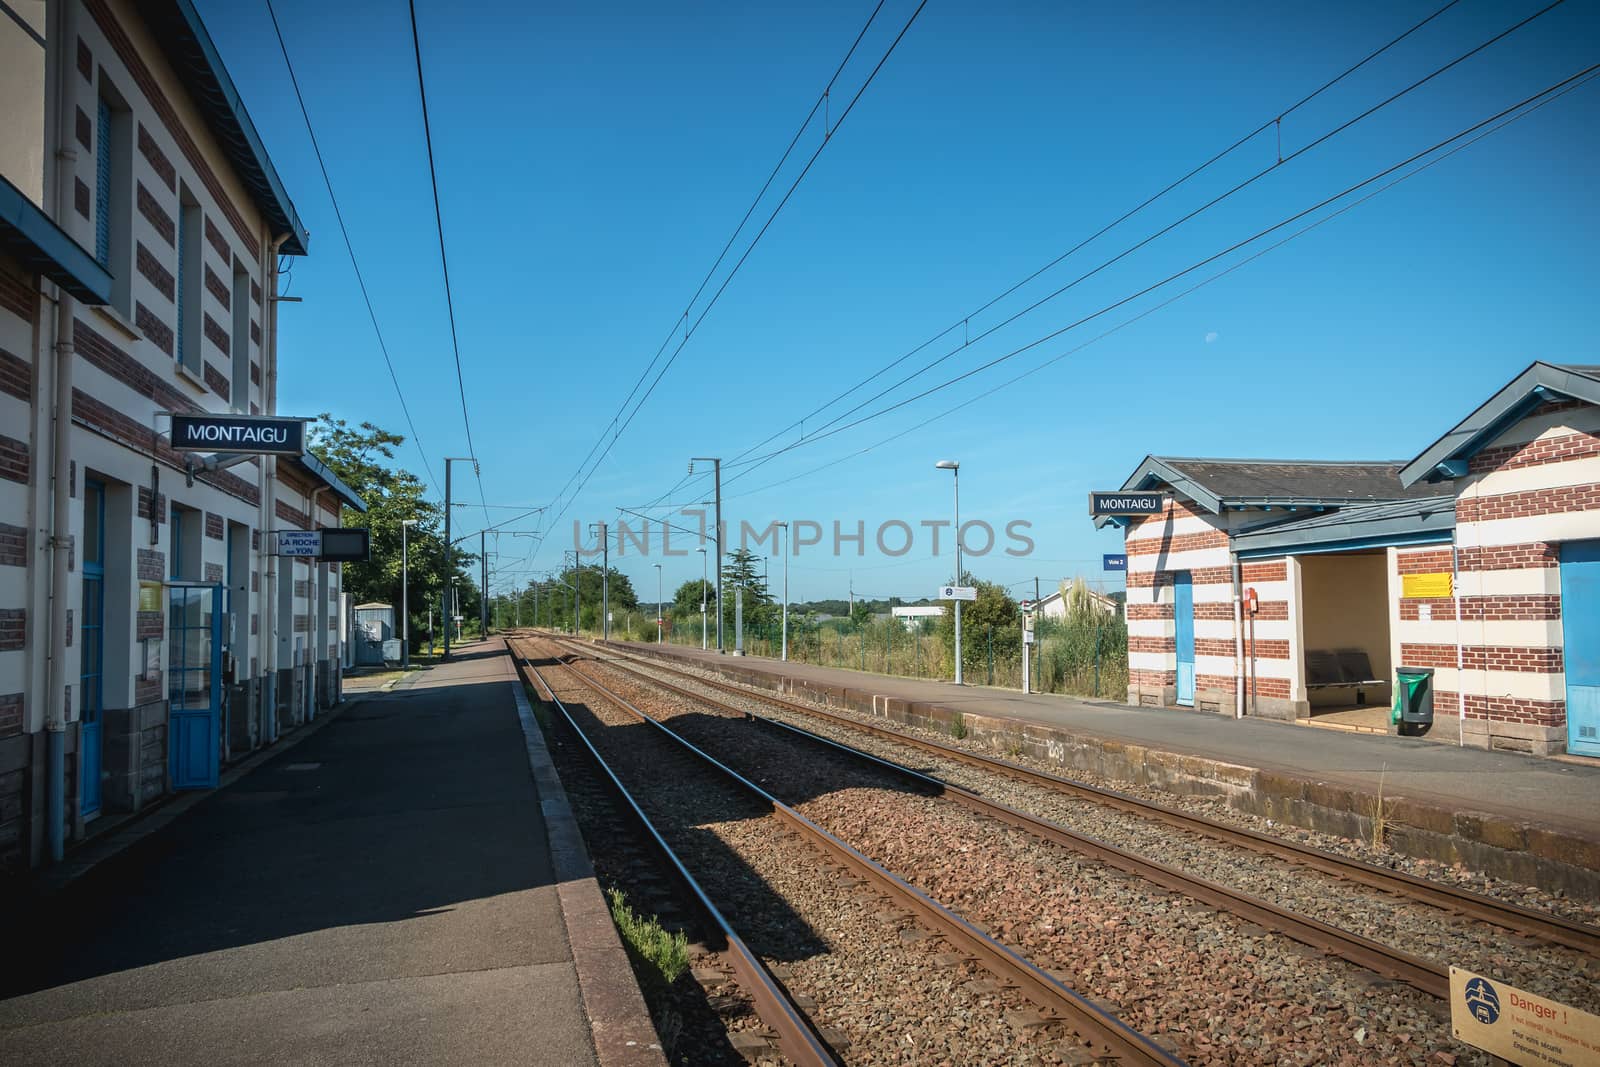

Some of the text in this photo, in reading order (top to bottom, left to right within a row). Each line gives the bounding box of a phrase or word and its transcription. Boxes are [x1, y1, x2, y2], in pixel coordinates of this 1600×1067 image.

[187, 424, 287, 443] MONTAIGU
[1100, 499, 1156, 509] MONTAIGU
[1510, 993, 1557, 1020] Danger
